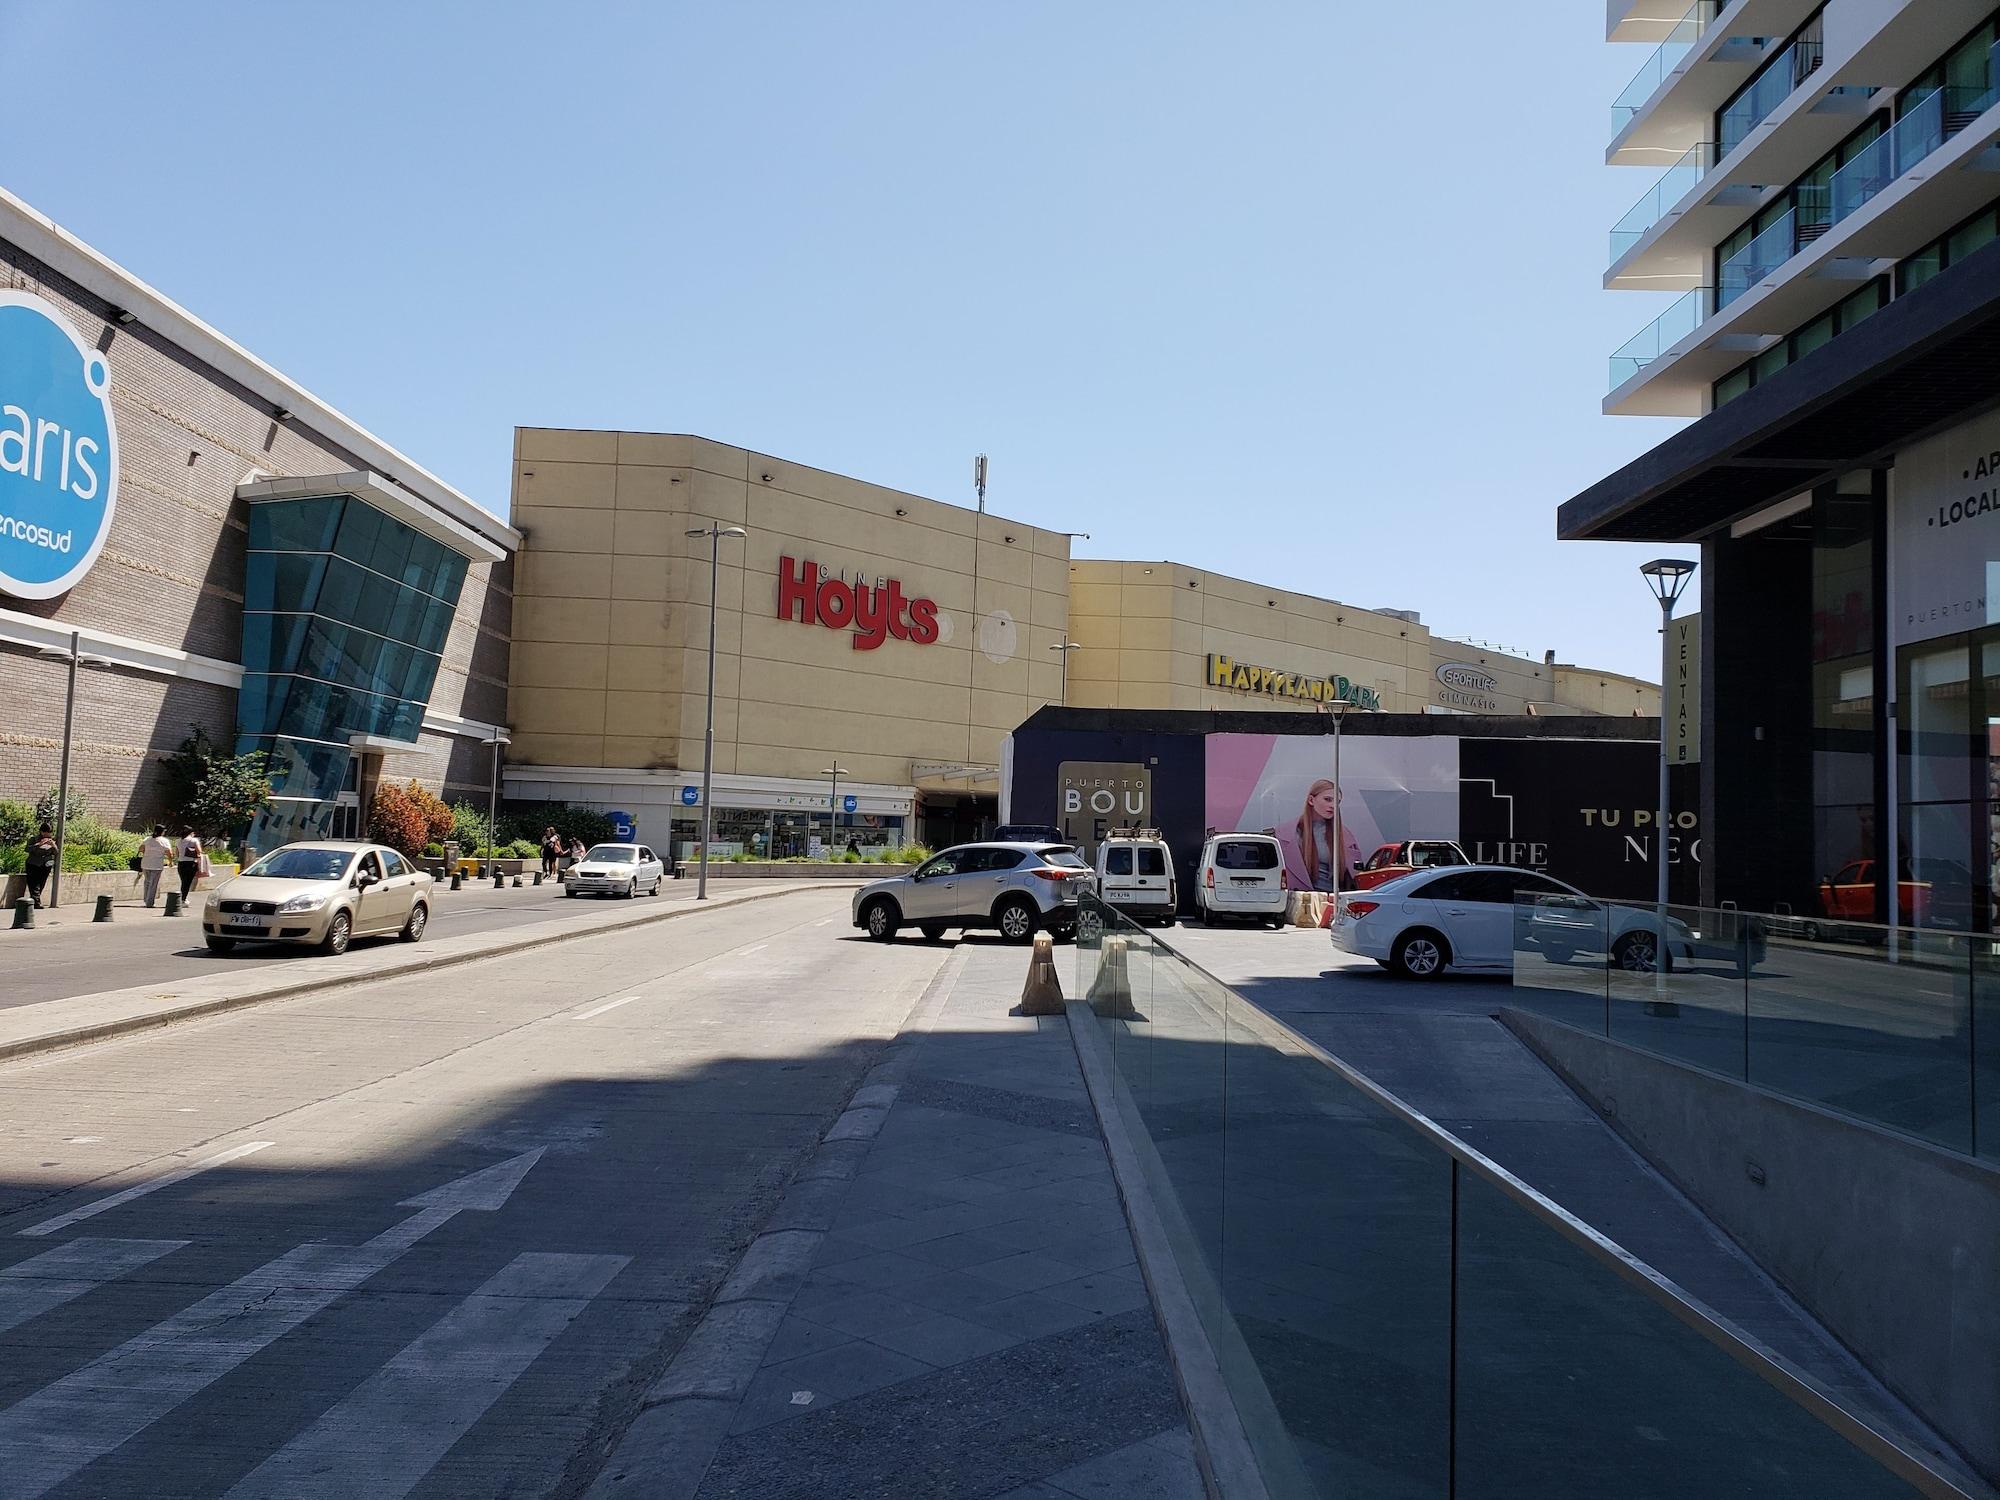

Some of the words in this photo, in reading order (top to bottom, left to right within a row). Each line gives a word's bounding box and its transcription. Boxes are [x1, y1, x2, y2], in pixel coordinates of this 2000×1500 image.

[820, 564, 885, 589] CINE
[777, 556, 939, 651] Hoyts
[1679, 624, 1688, 738] VENTAS
[1065, 778, 1144, 789] PUERTO
[1065, 789, 1144, 815] BOU
[1579, 808, 1621, 827] TU
[1474, 841, 1549, 865] LIFE
